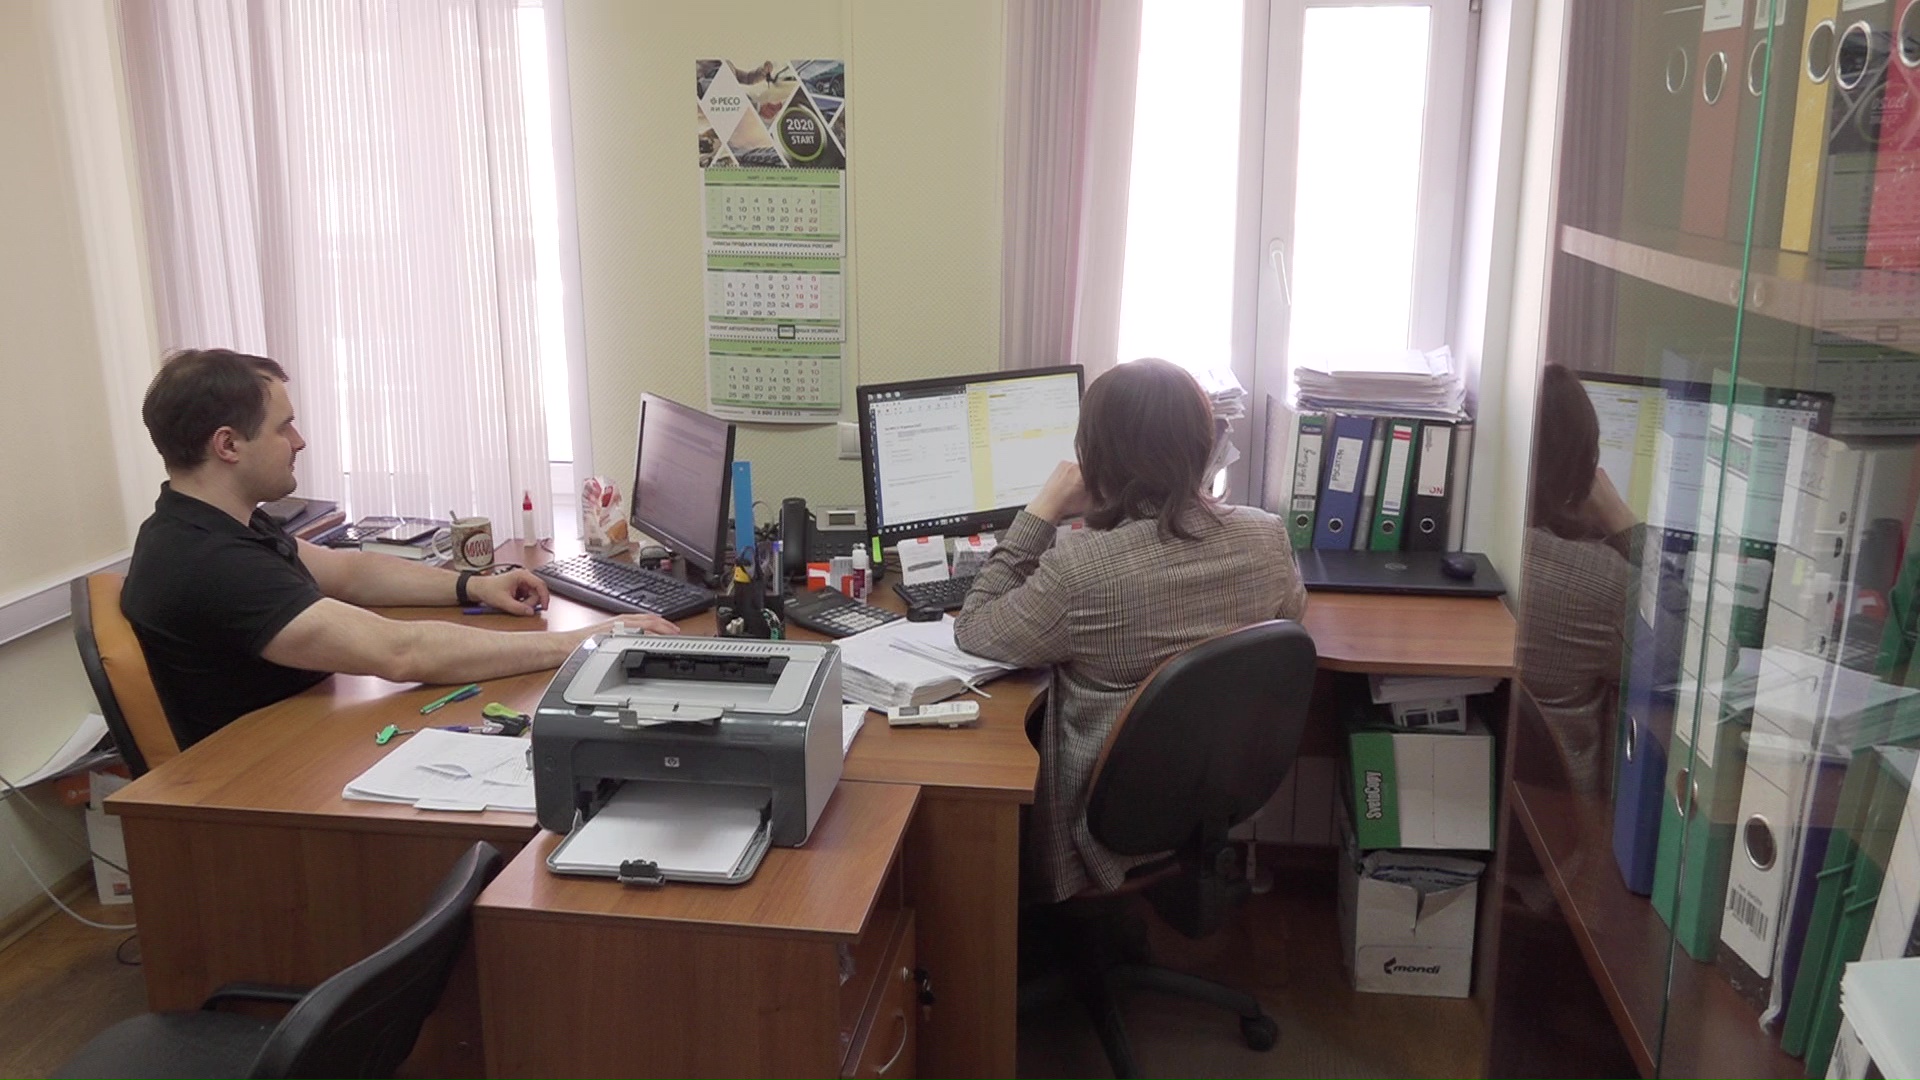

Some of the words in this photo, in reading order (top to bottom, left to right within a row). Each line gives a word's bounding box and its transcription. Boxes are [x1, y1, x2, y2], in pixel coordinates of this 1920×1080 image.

[718, 96, 741, 106] РЕСО
[786, 118, 814, 131] 2020
[790, 135, 815, 145] START
[1393, 964, 1441, 974] mondi
